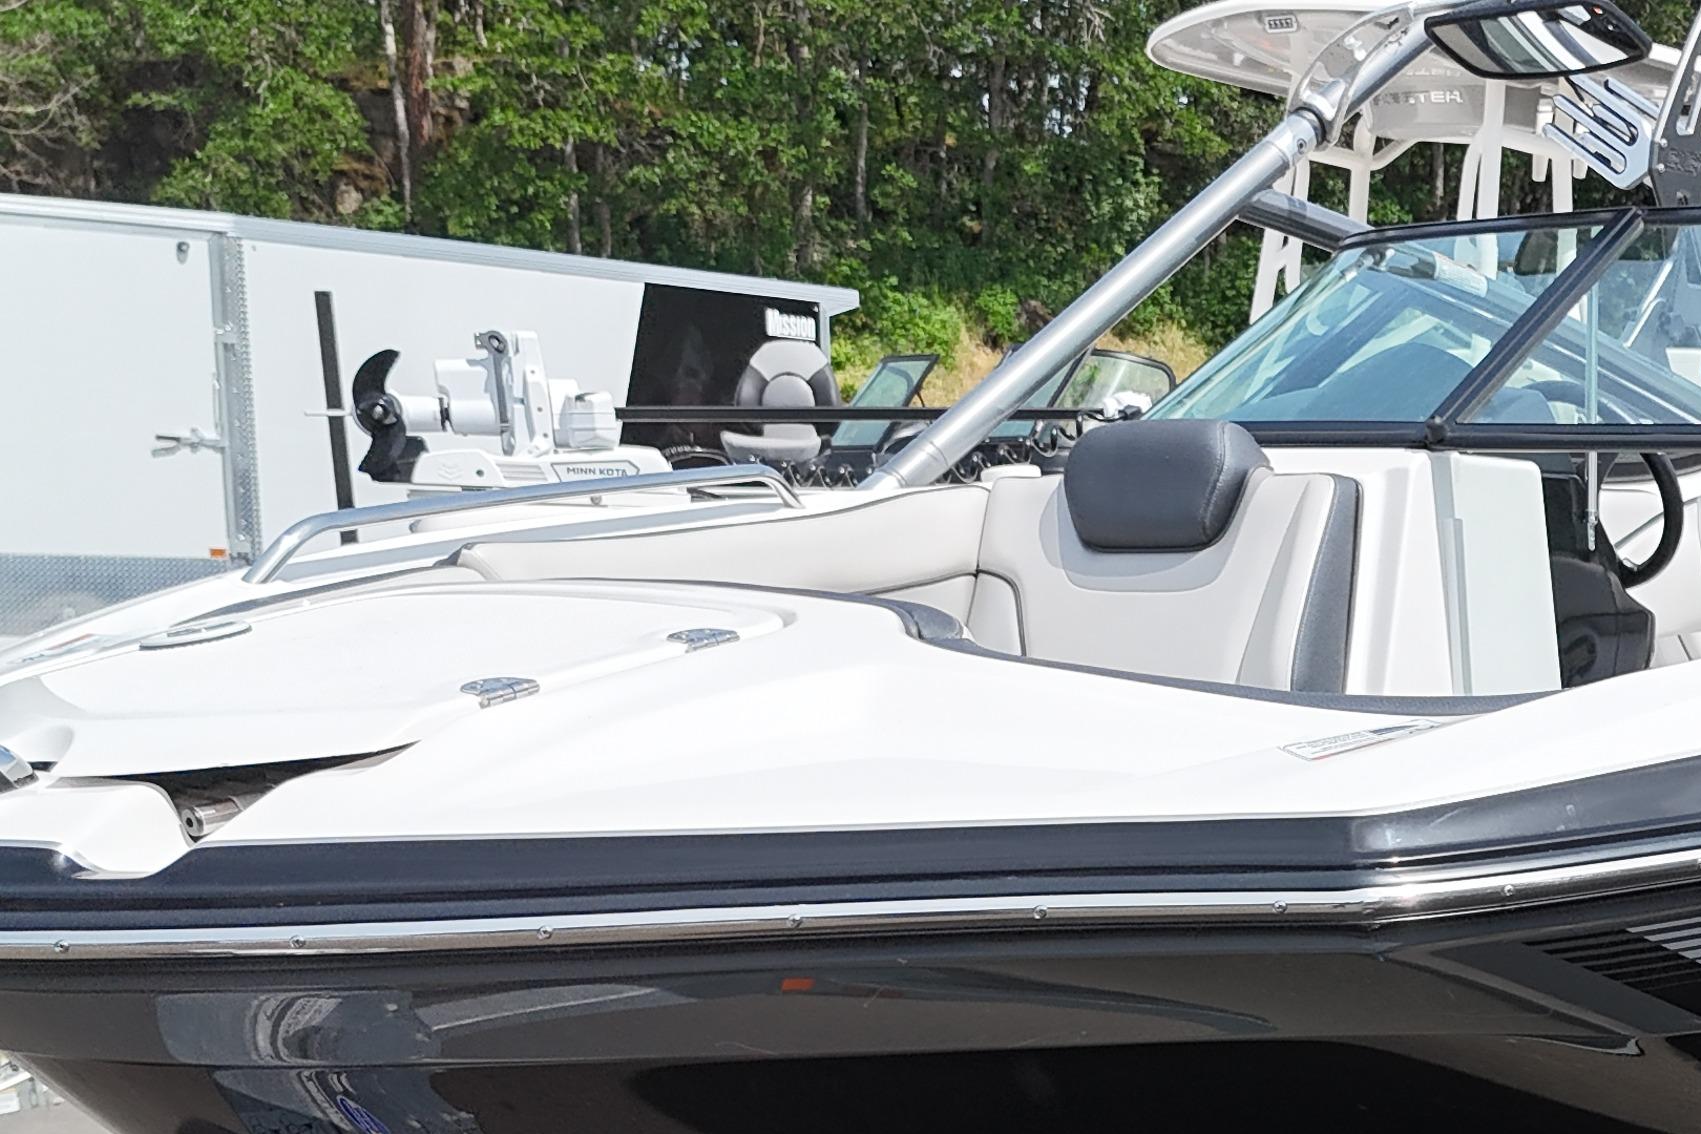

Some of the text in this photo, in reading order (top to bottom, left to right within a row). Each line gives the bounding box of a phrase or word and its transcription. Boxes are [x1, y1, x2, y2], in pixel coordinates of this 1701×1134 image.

[765, 307, 817, 341] Mission
[566, 466, 628, 478] MINN KOTA
